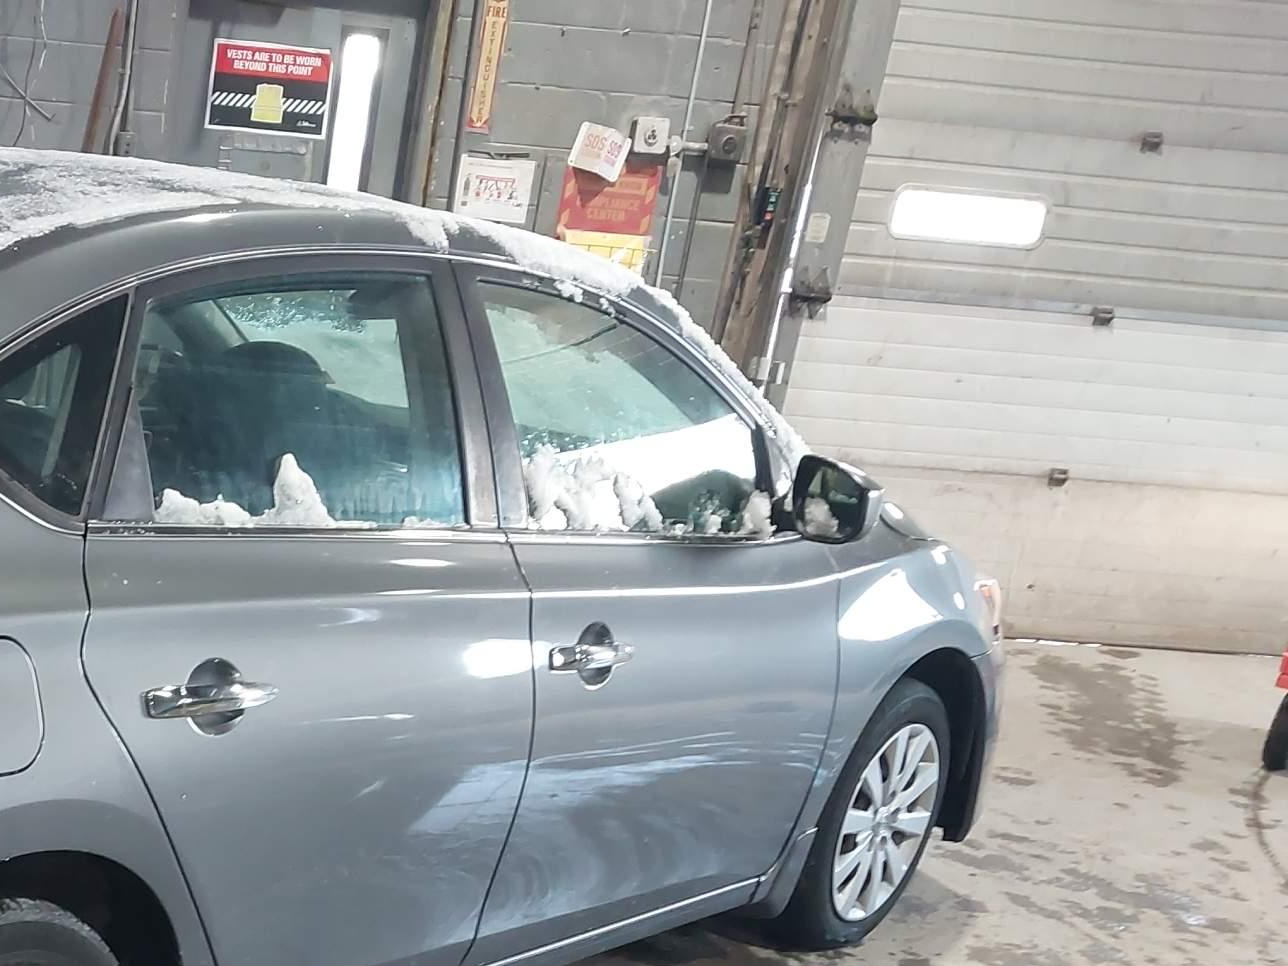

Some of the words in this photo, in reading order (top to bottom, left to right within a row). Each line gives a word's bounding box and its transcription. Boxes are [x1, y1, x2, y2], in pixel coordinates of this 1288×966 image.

[487, 6, 508, 17] FIRE
[227, 49, 252, 60] VESTS
[253, 52, 270, 61] ARE
[272, 54, 283, 63] TO
[284, 55, 295, 64] BE
[296, 56, 322, 67] WORN
[233, 60, 267, 72] BEYOND
[268, 64, 287, 73] THIS
[287, 65, 313, 76] POINT
[476, 21, 497, 123] EXTINGUISHER
